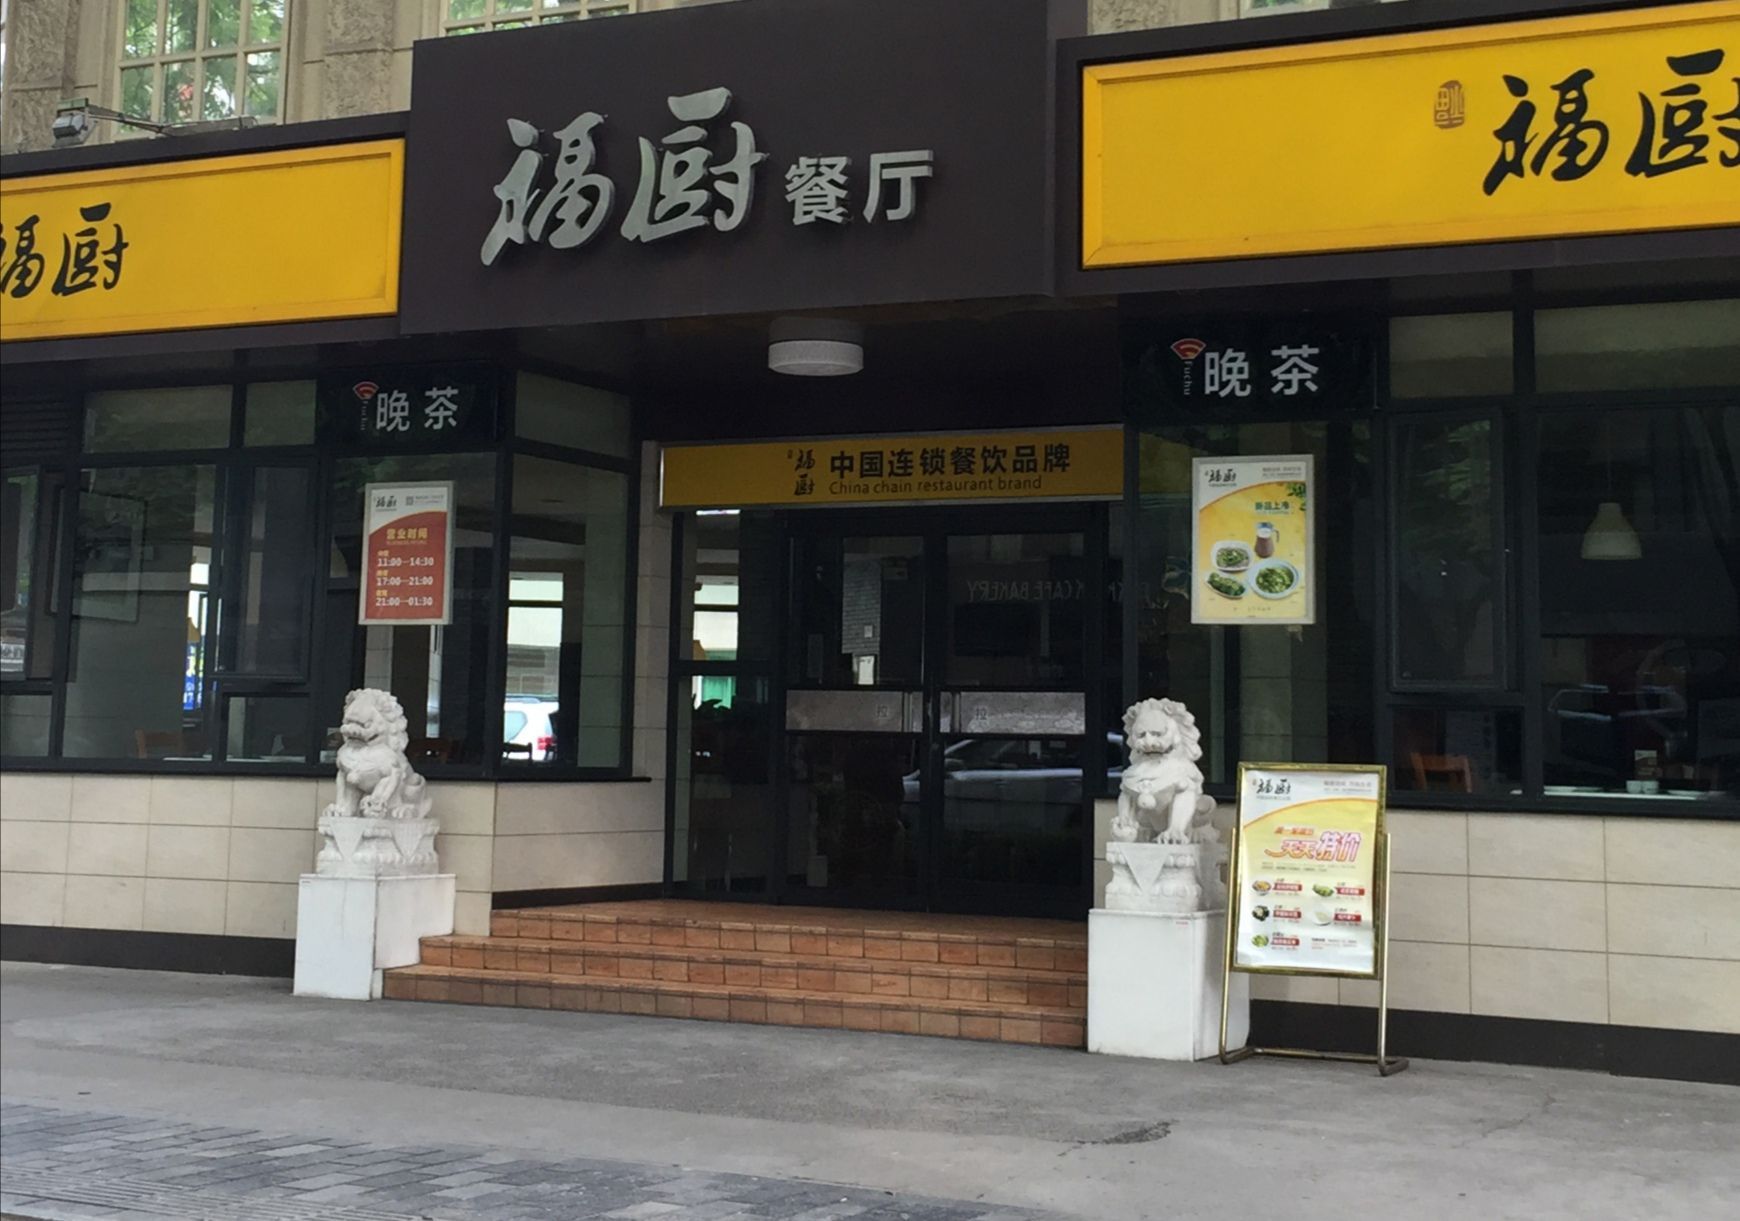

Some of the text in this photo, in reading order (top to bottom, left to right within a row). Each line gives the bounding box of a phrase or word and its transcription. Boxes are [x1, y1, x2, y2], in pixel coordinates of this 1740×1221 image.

[481, 86, 934, 266] 福厨 餐厅
[1204, 344, 1320, 397] 晚茶
[375, 386, 459, 432] 晚茶
[829, 443, 1072, 479] 中国连锁餐饮品牌
[828, 475, 1042, 496] China chain restaurant brand
